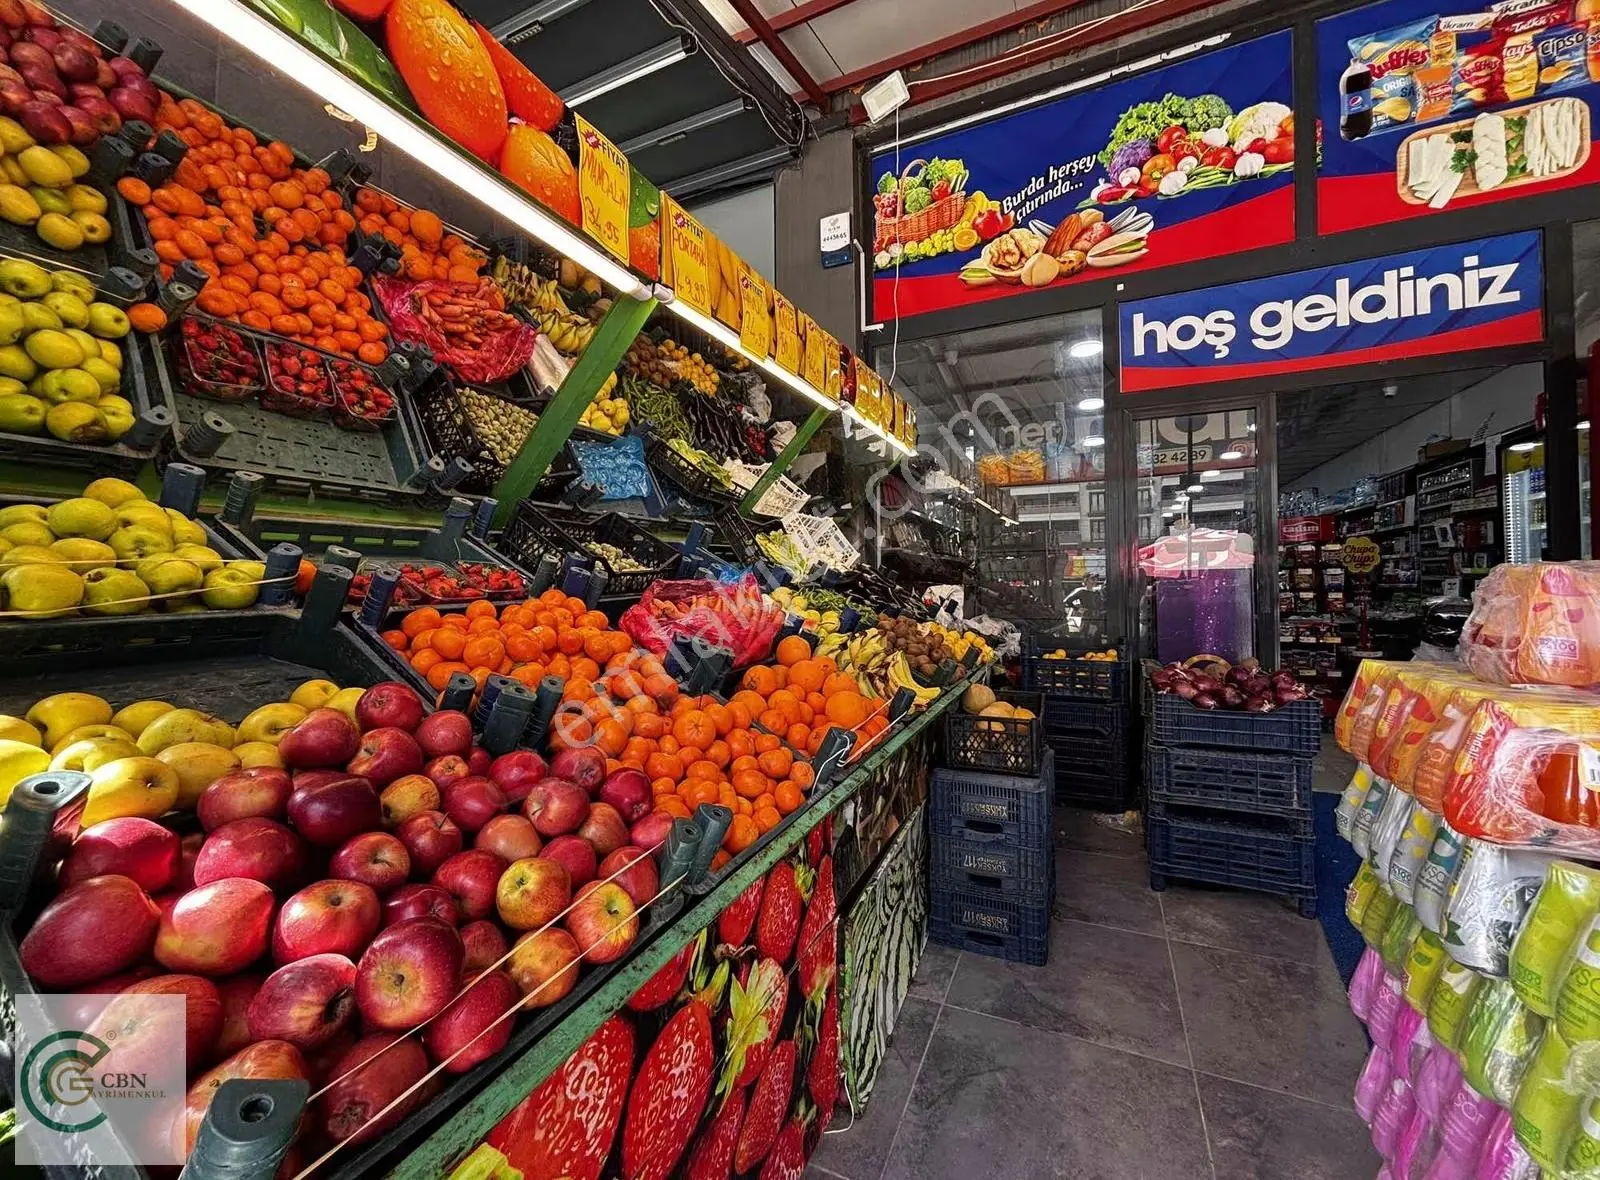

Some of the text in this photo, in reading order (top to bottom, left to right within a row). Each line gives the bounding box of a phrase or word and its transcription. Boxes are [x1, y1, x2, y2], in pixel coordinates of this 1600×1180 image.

[1002, 154, 1097, 214] Burda herşey
[1132, 255, 1521, 359] hoş geldiniz
[1342, 554, 1377, 564] Chups
[1343, 544, 1377, 556] Chupa
